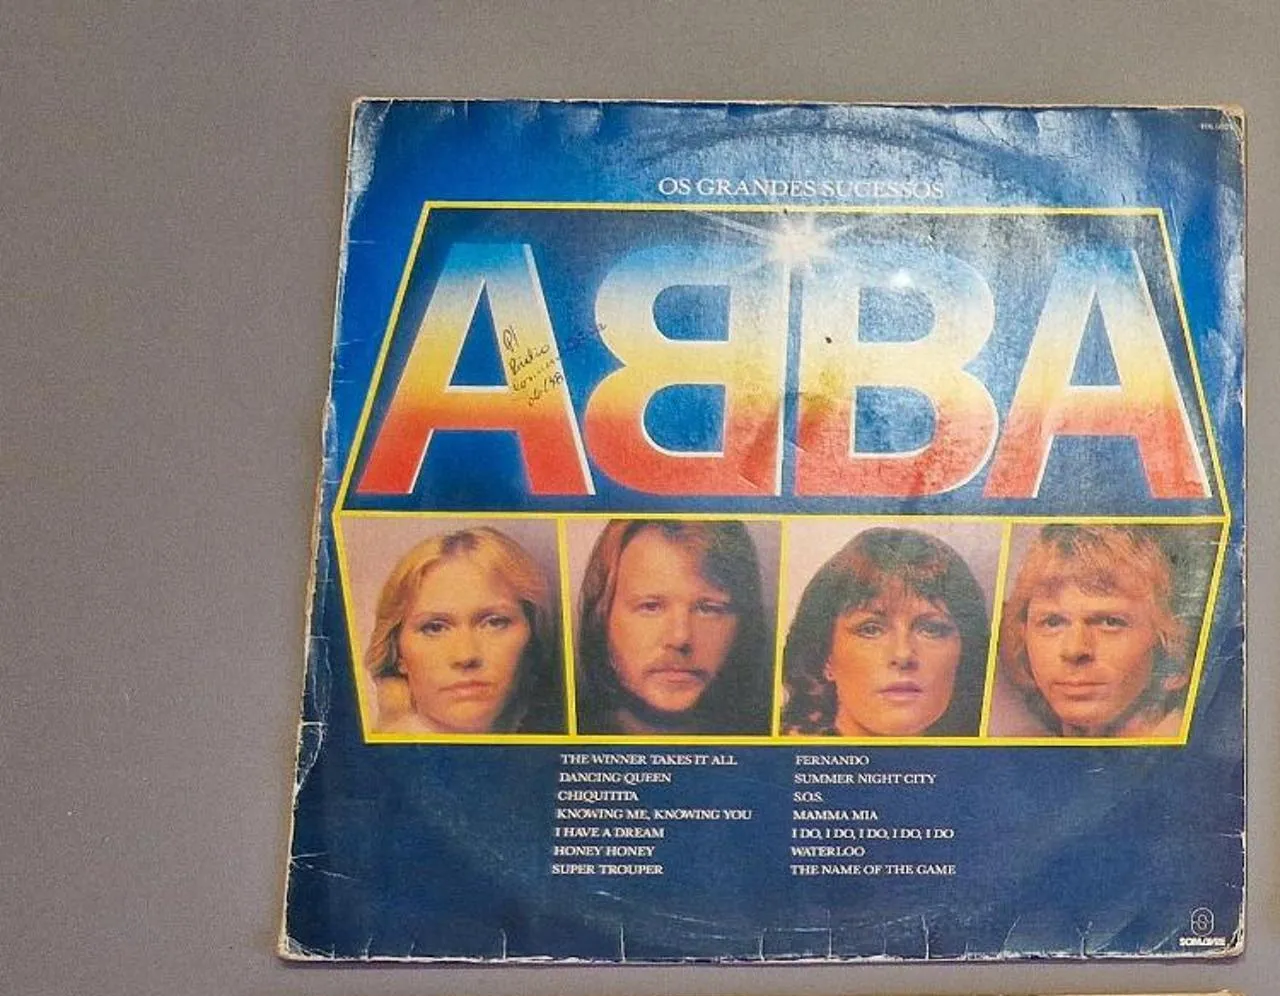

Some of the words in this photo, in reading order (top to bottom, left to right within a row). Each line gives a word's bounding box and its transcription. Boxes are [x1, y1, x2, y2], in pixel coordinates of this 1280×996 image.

[658, 177, 692, 196] OS
[697, 178, 817, 197] GRANDES
[820, 180, 945, 199] SUCESSOS
[355, 241, 1213, 498] ABBA
[560, 754, 590, 765] THE
[592, 754, 647, 765] WINNER
[650, 754, 693, 765] TAKES
[694, 754, 709, 765] IT
[711, 754, 738, 765] ALL
[795, 755, 870, 766] FERNANDO
[560, 772, 621, 783] DANCING
[624, 772, 672, 785] QUEEN
[794, 774, 855, 784] SUMMER
[857, 774, 902, 784] NIGHT
[903, 774, 937, 784] CITY
[556, 808, 624, 820] KNOWING
[626, 808, 650, 821] ME,
[653, 808, 719, 820] KNOWING
[723, 808, 753, 820] YOU
[793, 810, 849, 820] MAMMA
[851, 810, 878, 820] MIA
[555, 827, 561, 838] I
[563, 827, 600, 838] HAVE
[602, 827, 612, 838] A
[615, 827, 665, 838] DREAM
[791, 828, 797, 839] I
[826, 828, 831, 839] I
[859, 828, 864, 839] I
[892, 828, 898, 839] I
[926, 828, 931, 839] I
[933, 828, 955, 839] DO
[553, 846, 602, 856] HONEY
[606, 846, 655, 856] HONEY
[790, 846, 866, 857] WATERLOO
[552, 864, 596, 875] SUPER
[599, 864, 664, 875] TROUPER
[790, 865, 820, 875] THE
[821, 865, 862, 875] NAME
[863, 865, 882, 875] OF
[885, 865, 914, 875] THE
[916, 865, 957, 875] GAME
